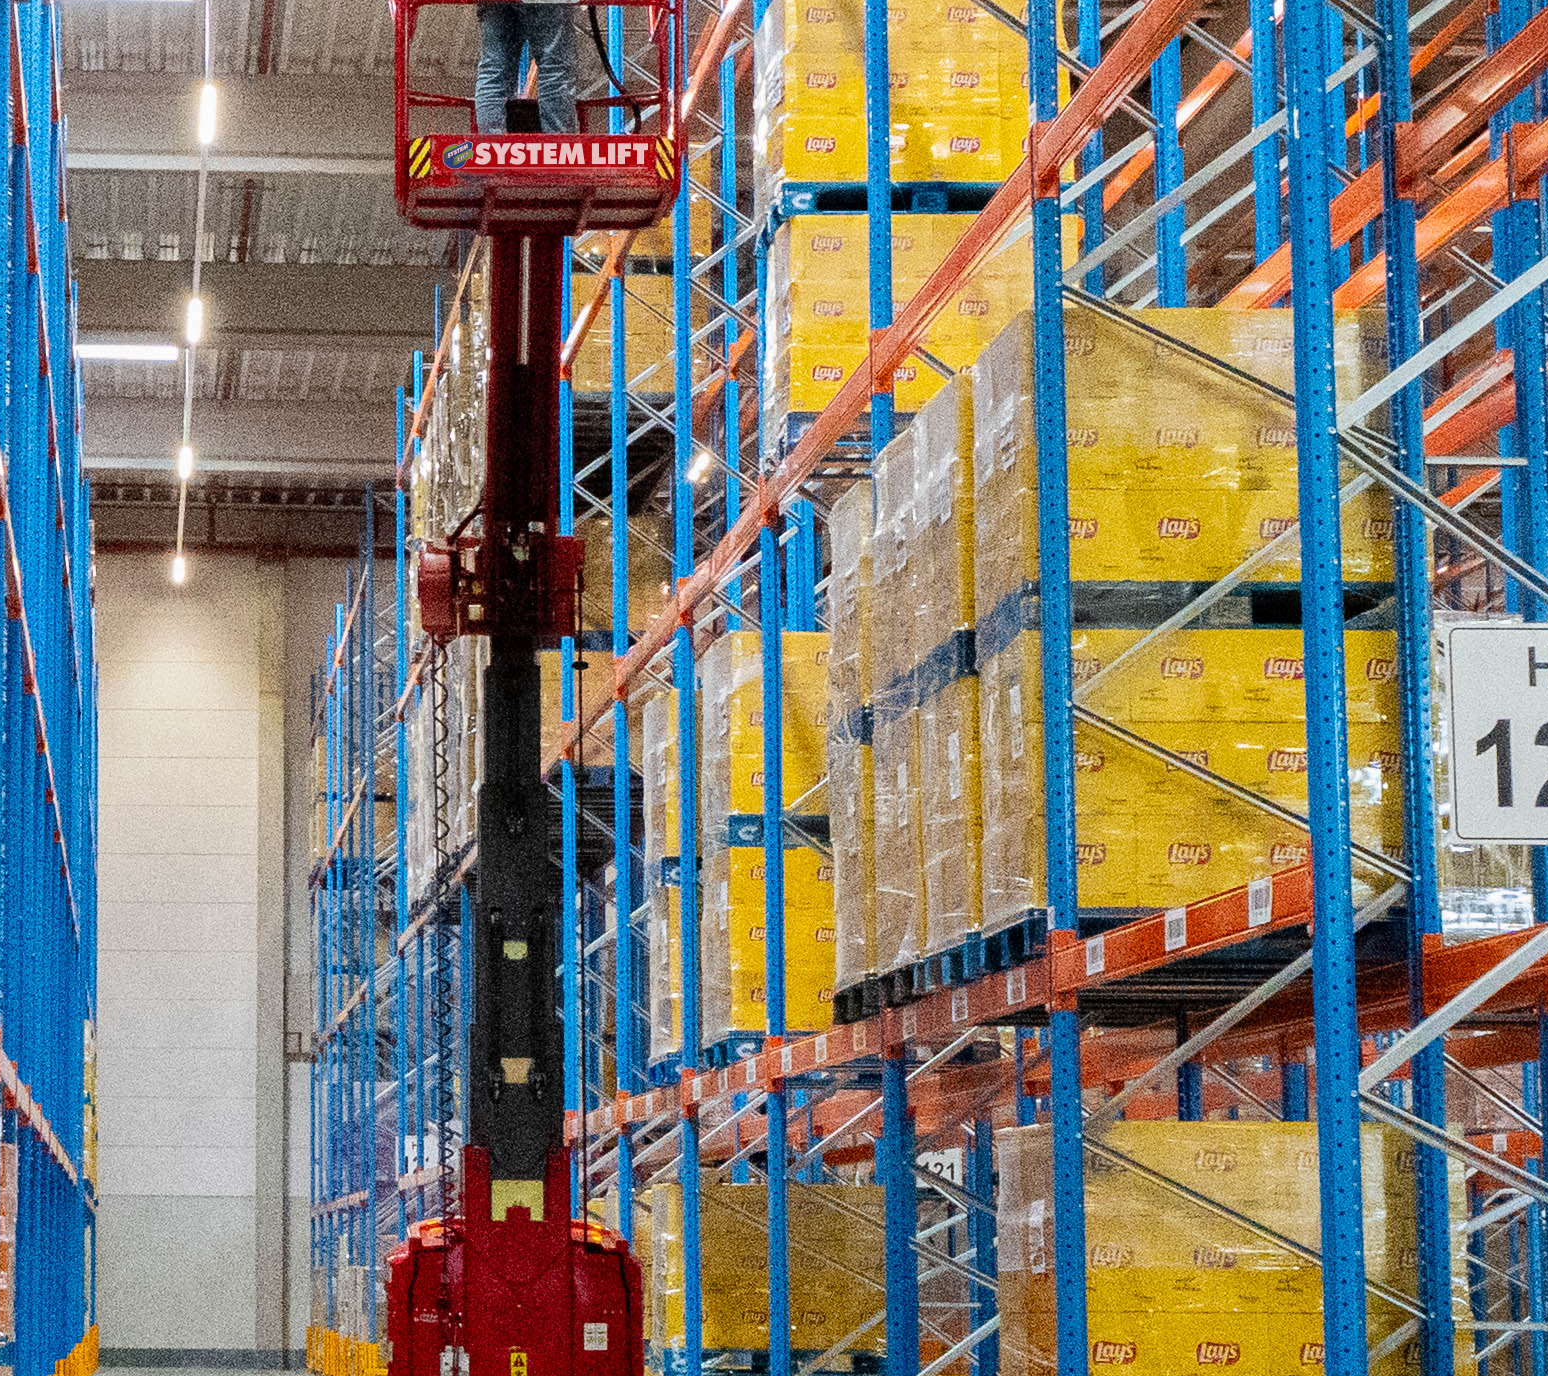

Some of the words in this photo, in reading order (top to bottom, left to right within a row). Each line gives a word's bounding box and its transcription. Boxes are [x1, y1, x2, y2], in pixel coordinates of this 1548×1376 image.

[447, 142, 469, 159] SYSTEM
[475, 142, 586, 165] SYSTEM
[591, 142, 649, 165] LIFT
